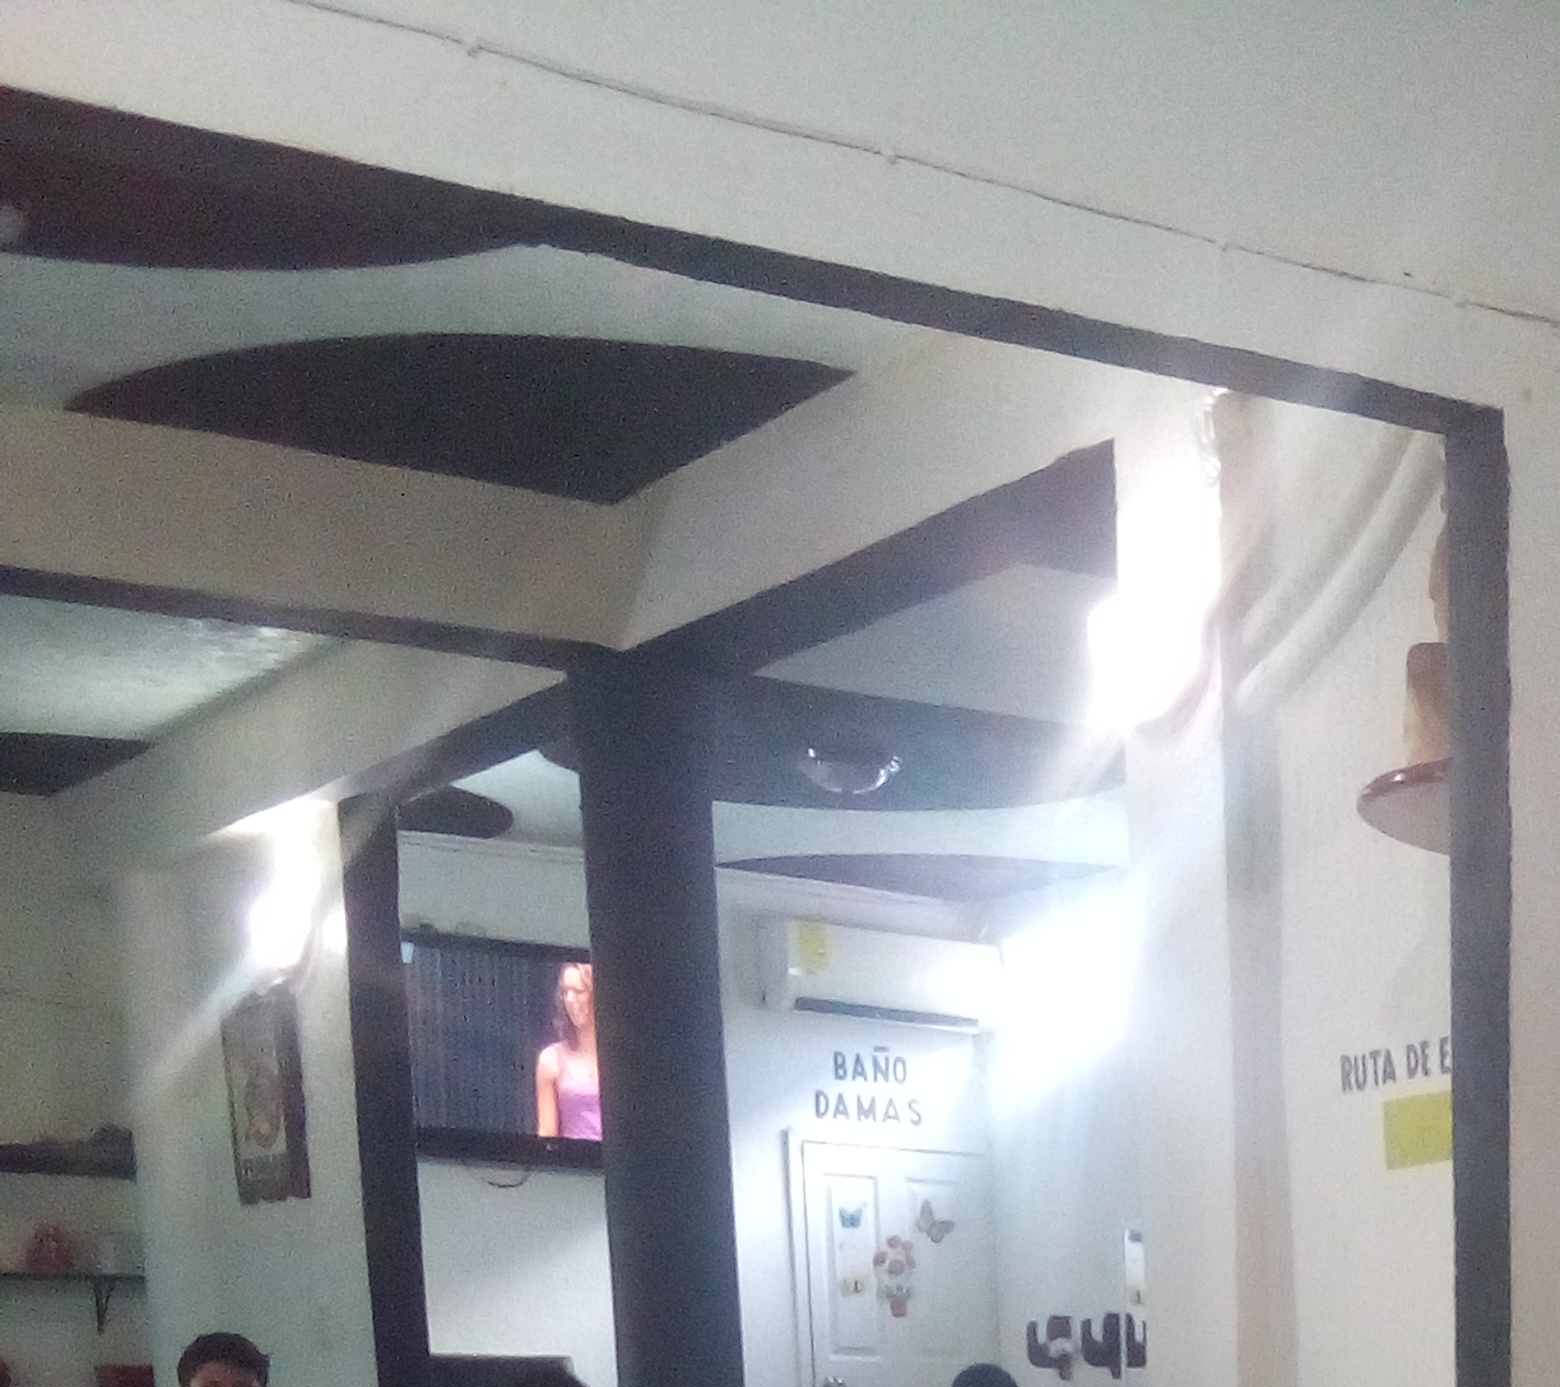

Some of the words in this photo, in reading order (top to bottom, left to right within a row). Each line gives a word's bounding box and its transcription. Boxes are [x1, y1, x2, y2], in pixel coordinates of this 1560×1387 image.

[832, 1045, 907, 1085] BAÑO
[1340, 1047, 1397, 1093] RUTA
[1406, 1039, 1430, 1080] DE
[814, 1089, 923, 1127] DAMAS
